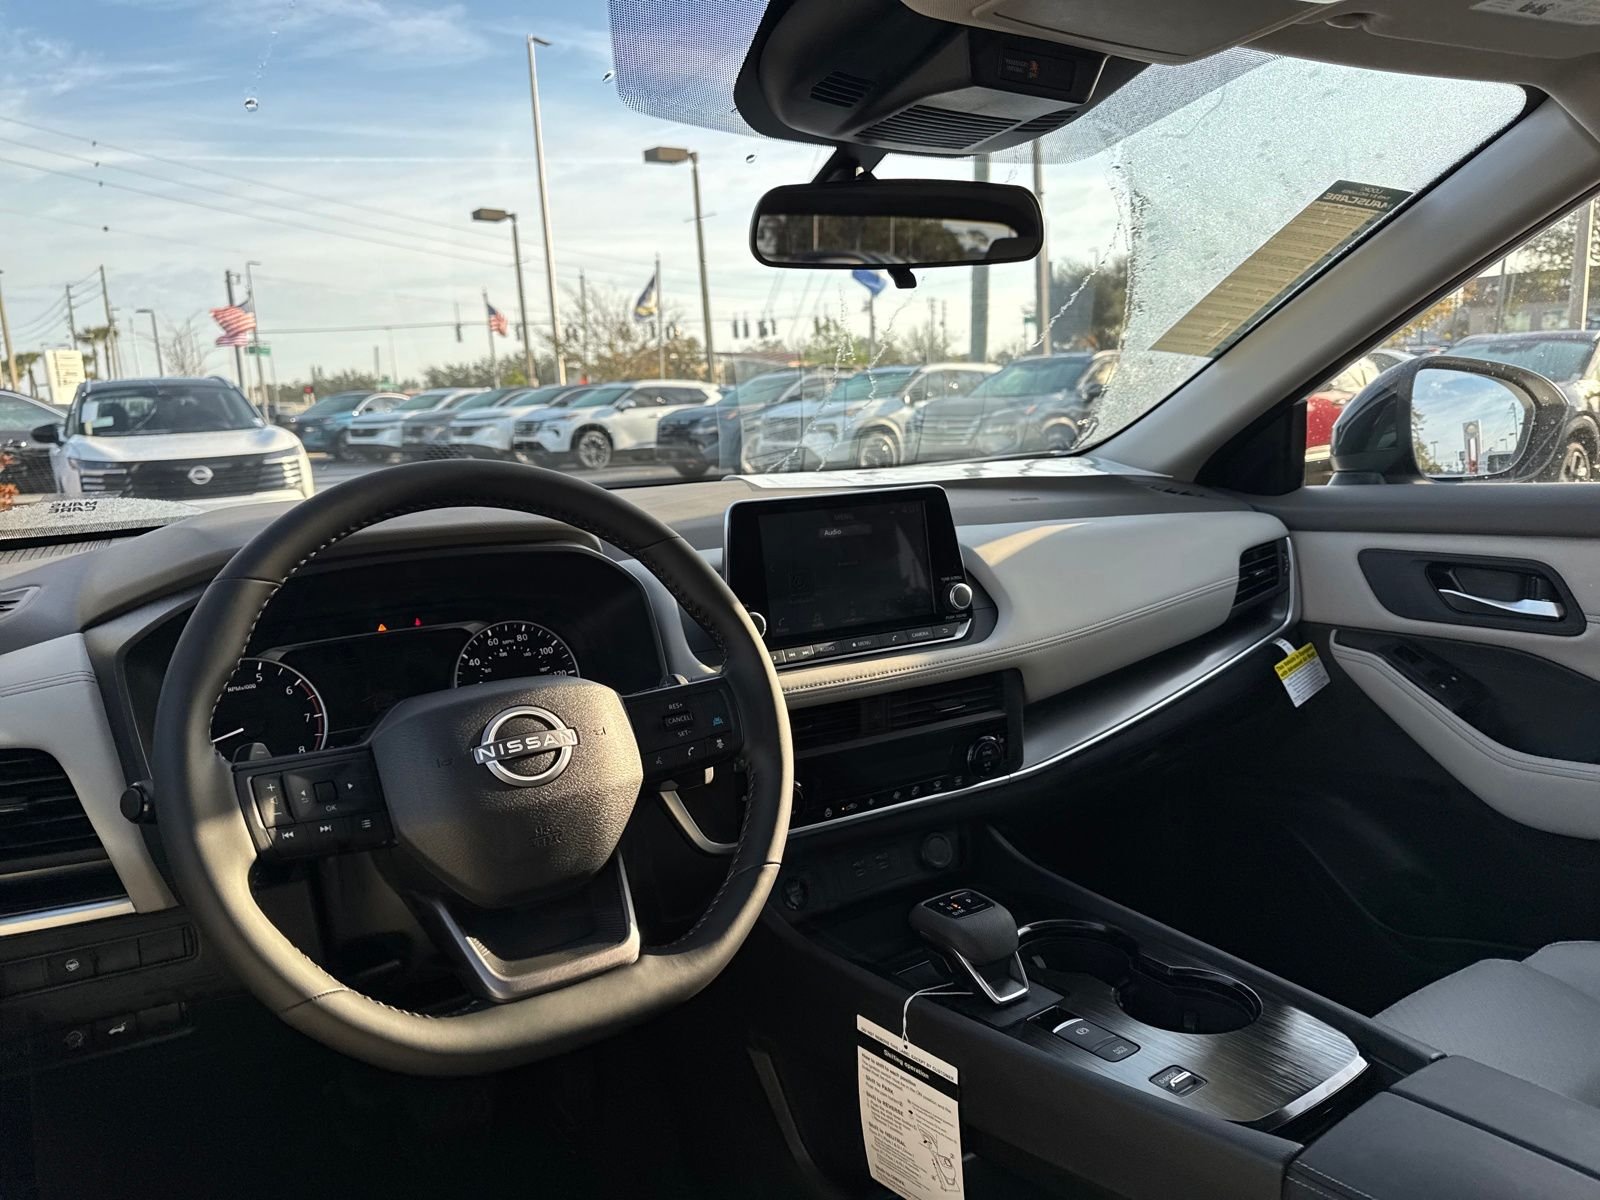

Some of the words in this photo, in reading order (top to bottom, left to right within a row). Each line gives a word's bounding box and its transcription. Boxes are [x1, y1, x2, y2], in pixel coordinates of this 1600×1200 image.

[823, 528, 842, 536] Audio
[911, 630, 929, 638] CAMERA
[487, 637, 498, 646] 60
[516, 633, 528, 641] 80
[539, 646, 553, 655] 100
[468, 657, 480, 666] 40
[255, 672, 263, 682] 5
[285, 685, 293, 695] 6
[303, 712, 310, 723] 7
[667, 715, 690, 724] CANCEL
[297, 744, 305, 753] 8
[477, 730, 575, 760] NISSAN
[325, 804, 337, 812] OK
[883, 1048, 903, 1066] Shifting
[904, 1061, 929, 1080] operation
[932, 1065, 953, 1080] CUSTOMER
